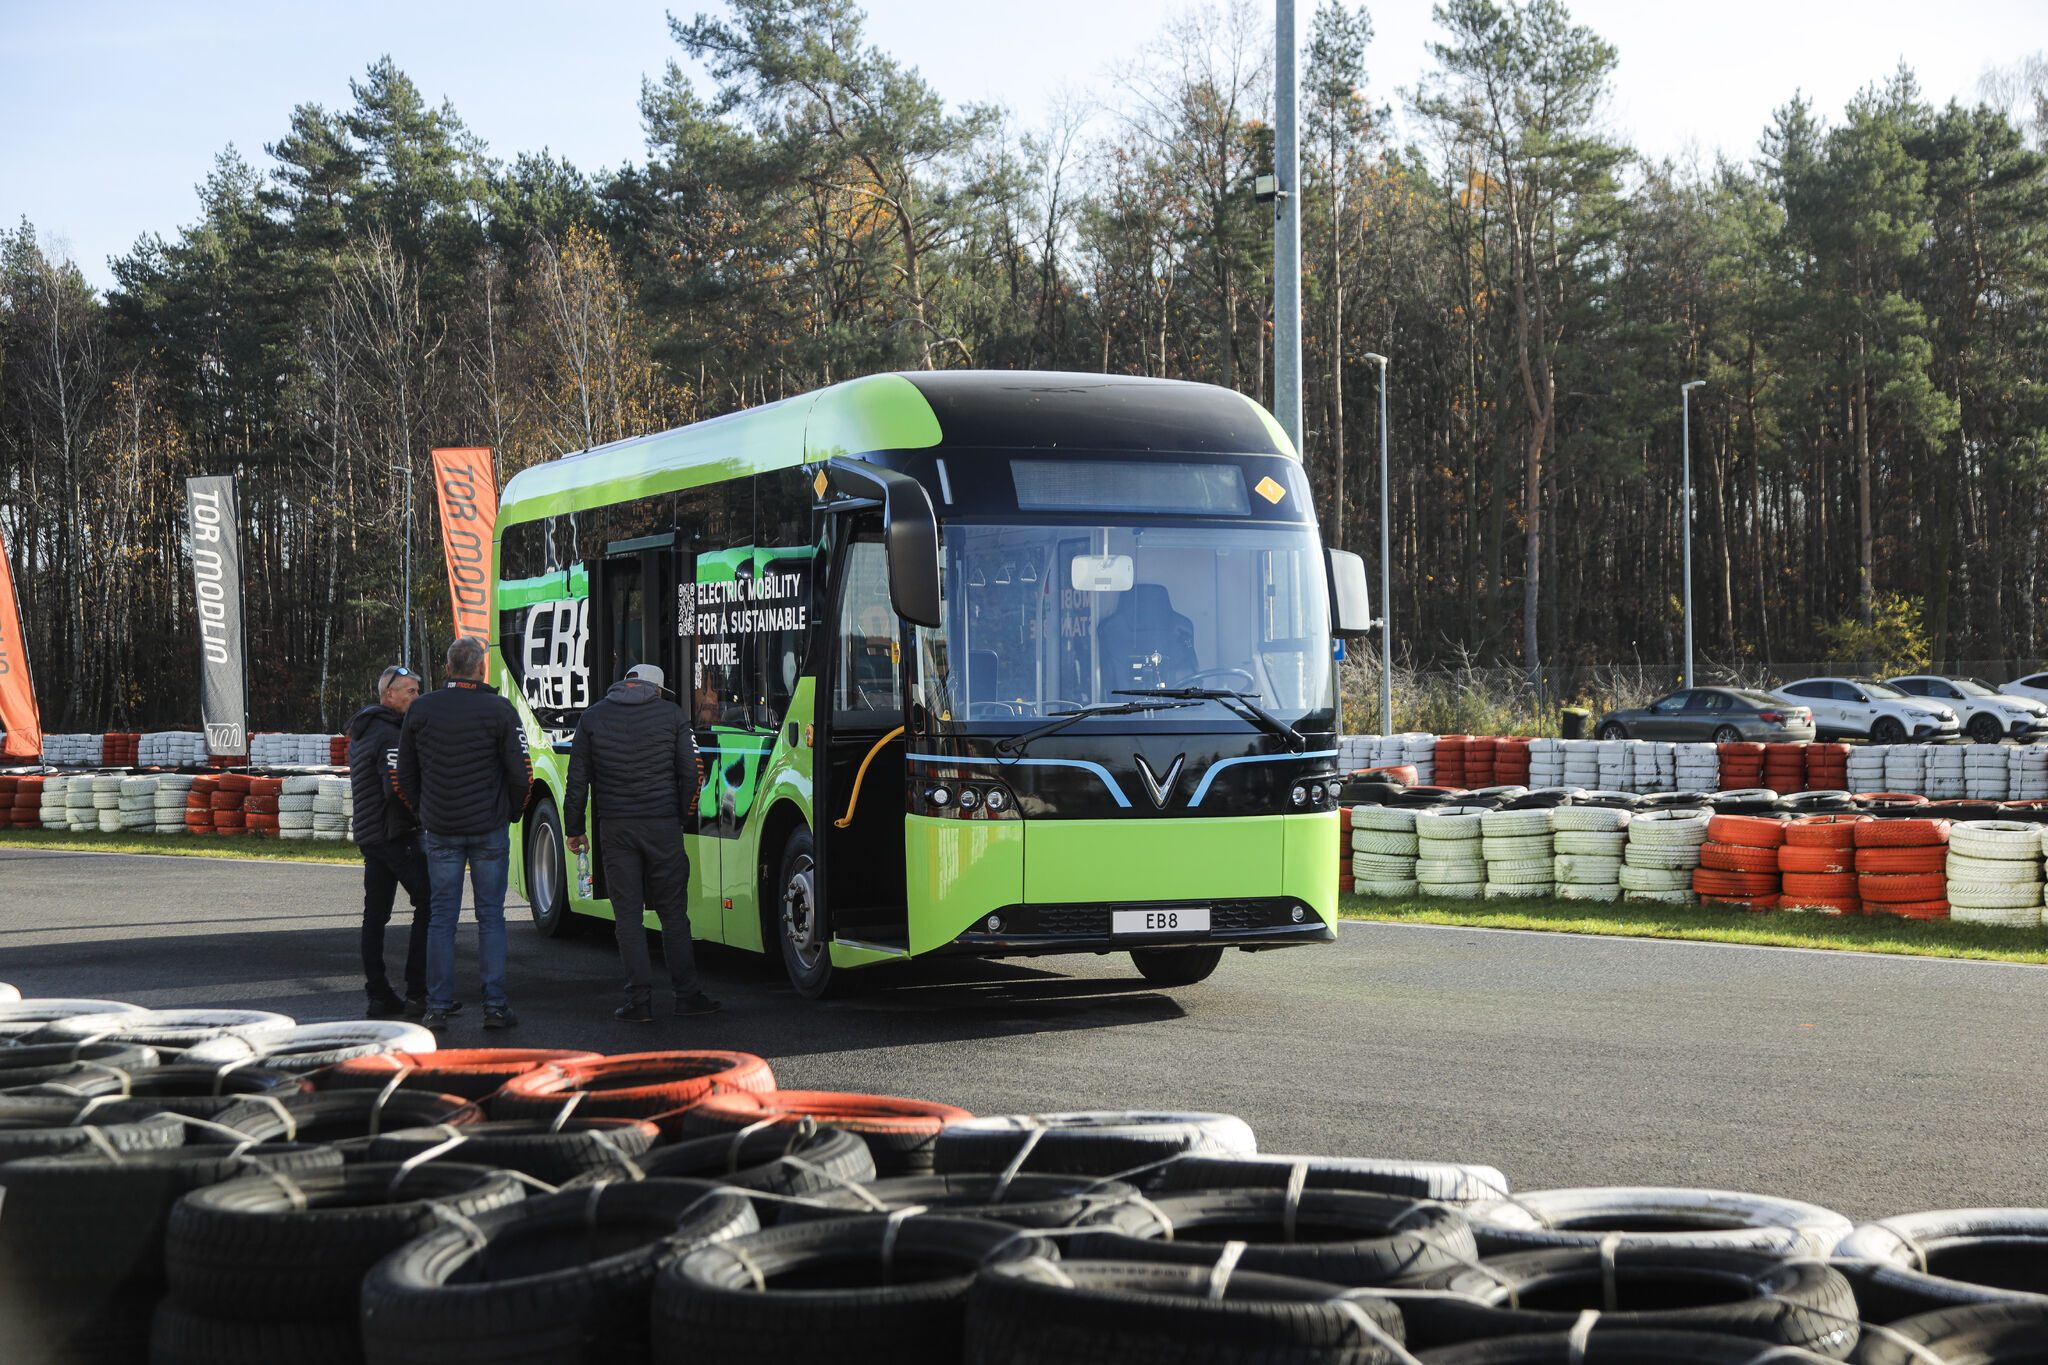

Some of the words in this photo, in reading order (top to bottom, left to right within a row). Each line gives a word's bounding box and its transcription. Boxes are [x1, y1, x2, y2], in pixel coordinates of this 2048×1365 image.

[443, 465, 477, 521] TOR
[193, 490, 220, 544] TOR
[697, 580, 745, 605] ELECTRIC
[747, 573, 800, 601] MOBILITY
[195, 549, 228, 664] MODLIN
[697, 613, 717, 635] FOR
[720, 612, 729, 634] A
[731, 606, 806, 634] SUSTAINABLE
[697, 643, 740, 666] FUTURE.
[1146, 913, 1178, 929] EB8
